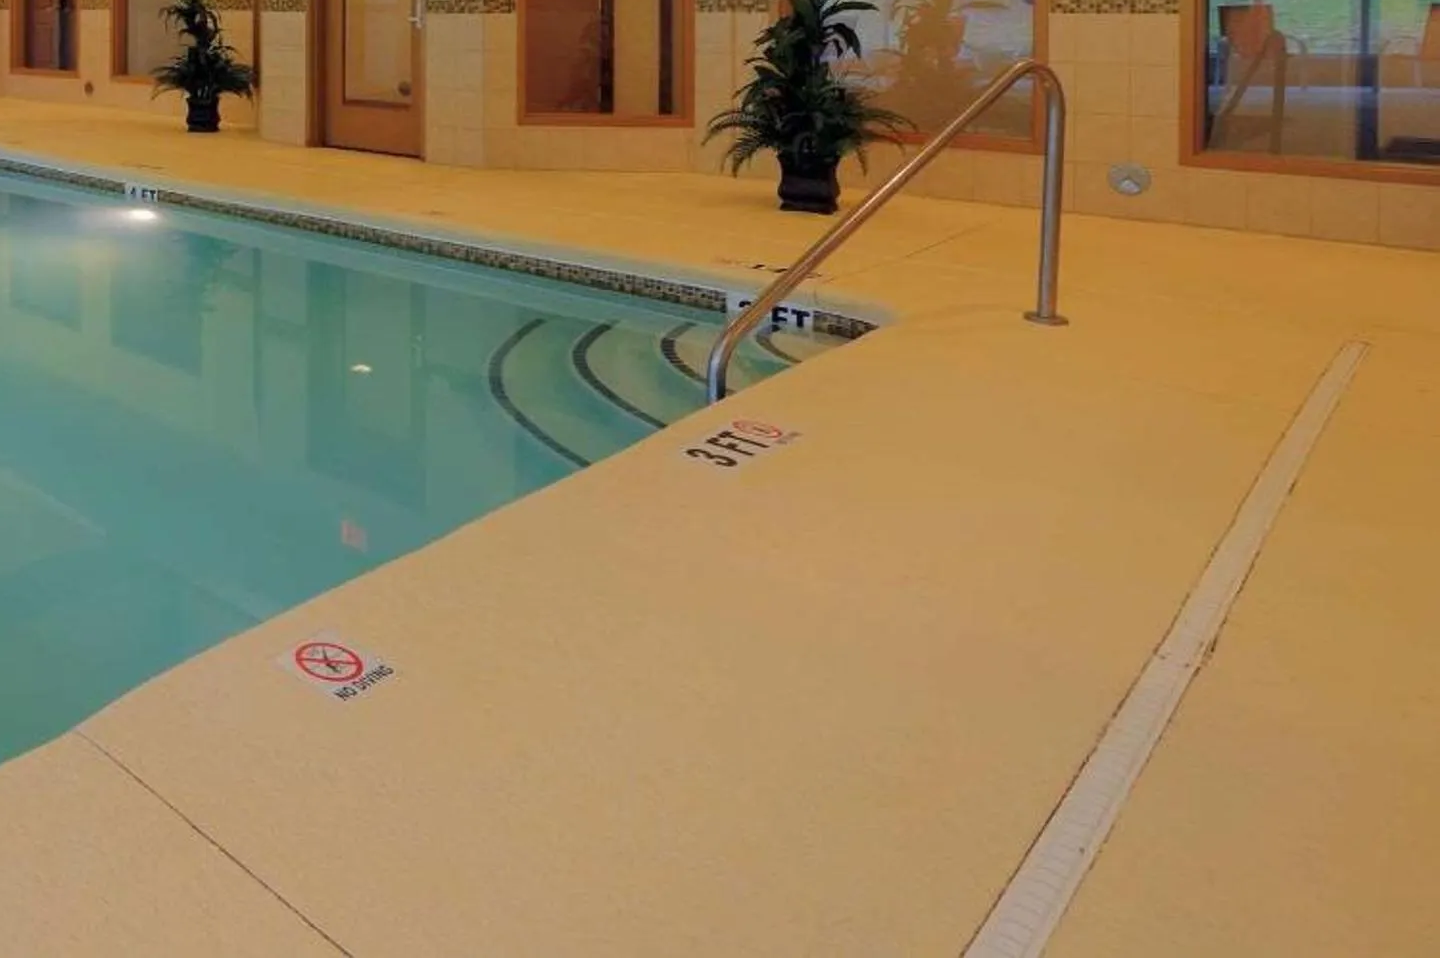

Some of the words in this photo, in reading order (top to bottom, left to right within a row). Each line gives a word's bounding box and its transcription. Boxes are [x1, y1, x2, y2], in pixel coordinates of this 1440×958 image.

[771, 306, 811, 329] FT
[706, 431, 770, 457] FT
[685, 448, 738, 468] 3
[333, 686, 358, 702] NO
[352, 664, 395, 691] DIVING
